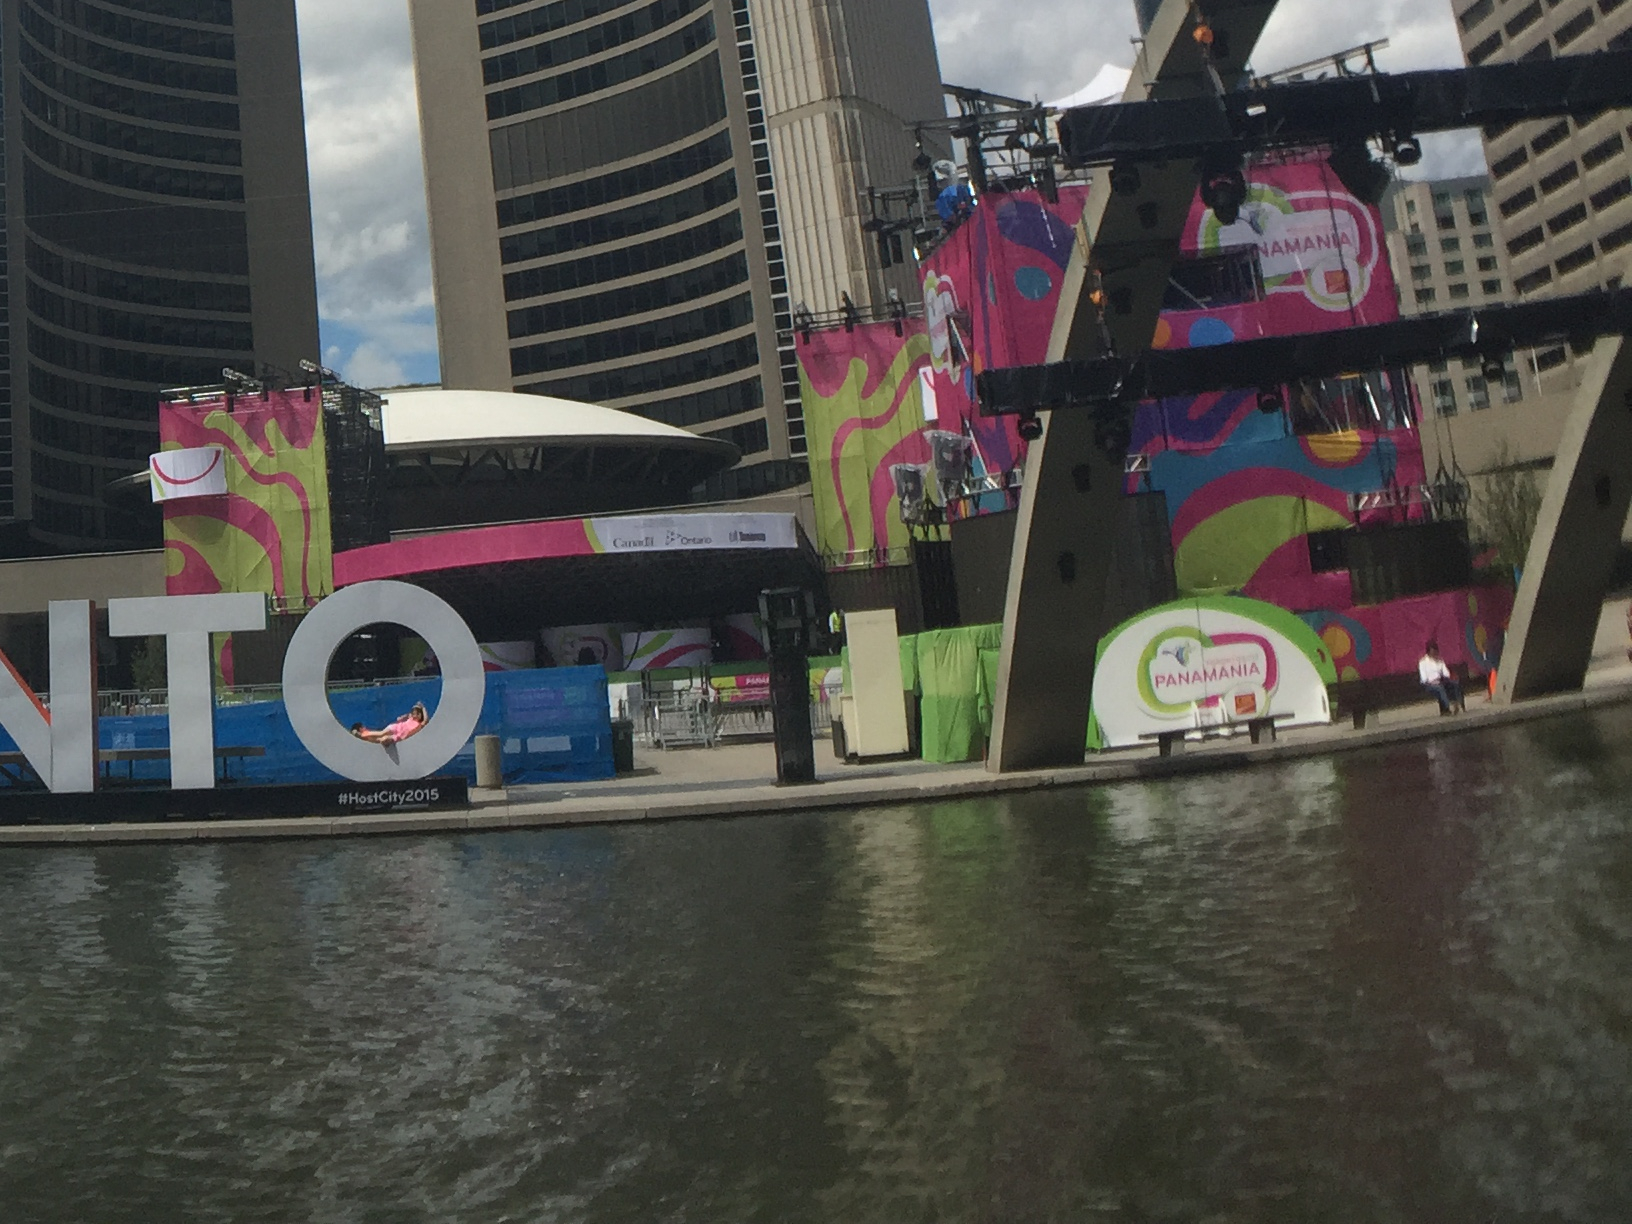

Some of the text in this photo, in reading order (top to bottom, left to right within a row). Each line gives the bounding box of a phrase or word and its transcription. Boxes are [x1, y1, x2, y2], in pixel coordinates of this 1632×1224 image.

[1256, 232, 1351, 257] NAMANIA
[680, 536, 712, 545] Ontario
[1154, 662, 1260, 688] PANAMANIA
[338, 788, 440, 805] #HostCity2015
